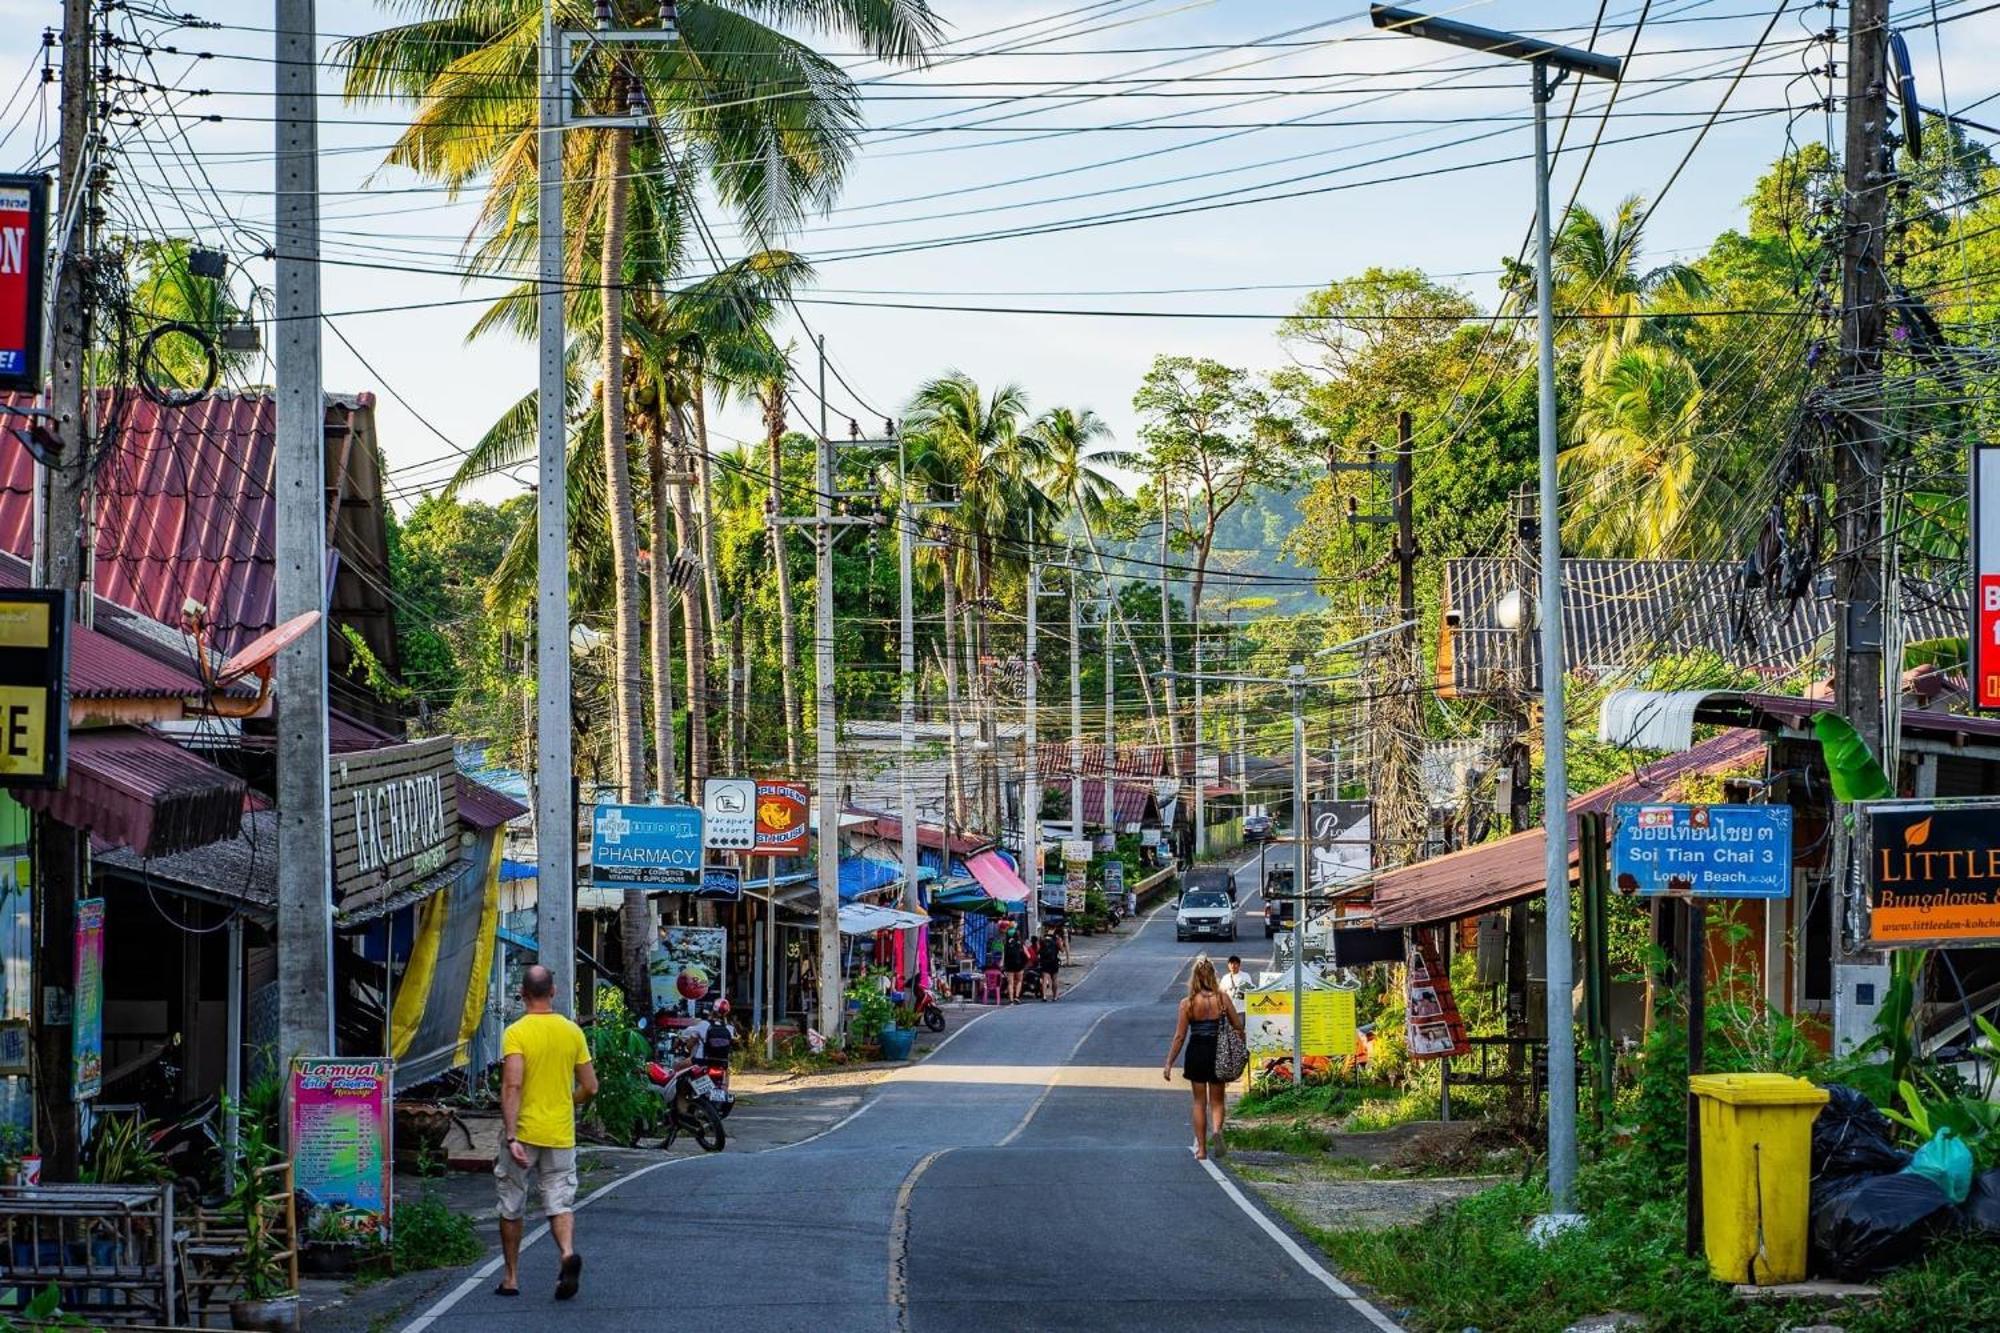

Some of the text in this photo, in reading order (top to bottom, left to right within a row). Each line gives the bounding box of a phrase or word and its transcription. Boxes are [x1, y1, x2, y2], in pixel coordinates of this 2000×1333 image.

[0, 227, 25, 274] N
[0, 706, 29, 756] E
[773, 826, 805, 842] HOUSE
[598, 847, 696, 864] PHARMACY
[1629, 848, 1773, 863] Soi Tian Chai 3
[1703, 870, 1746, 882] Beach
[1881, 888, 1987, 914] Bungalows
